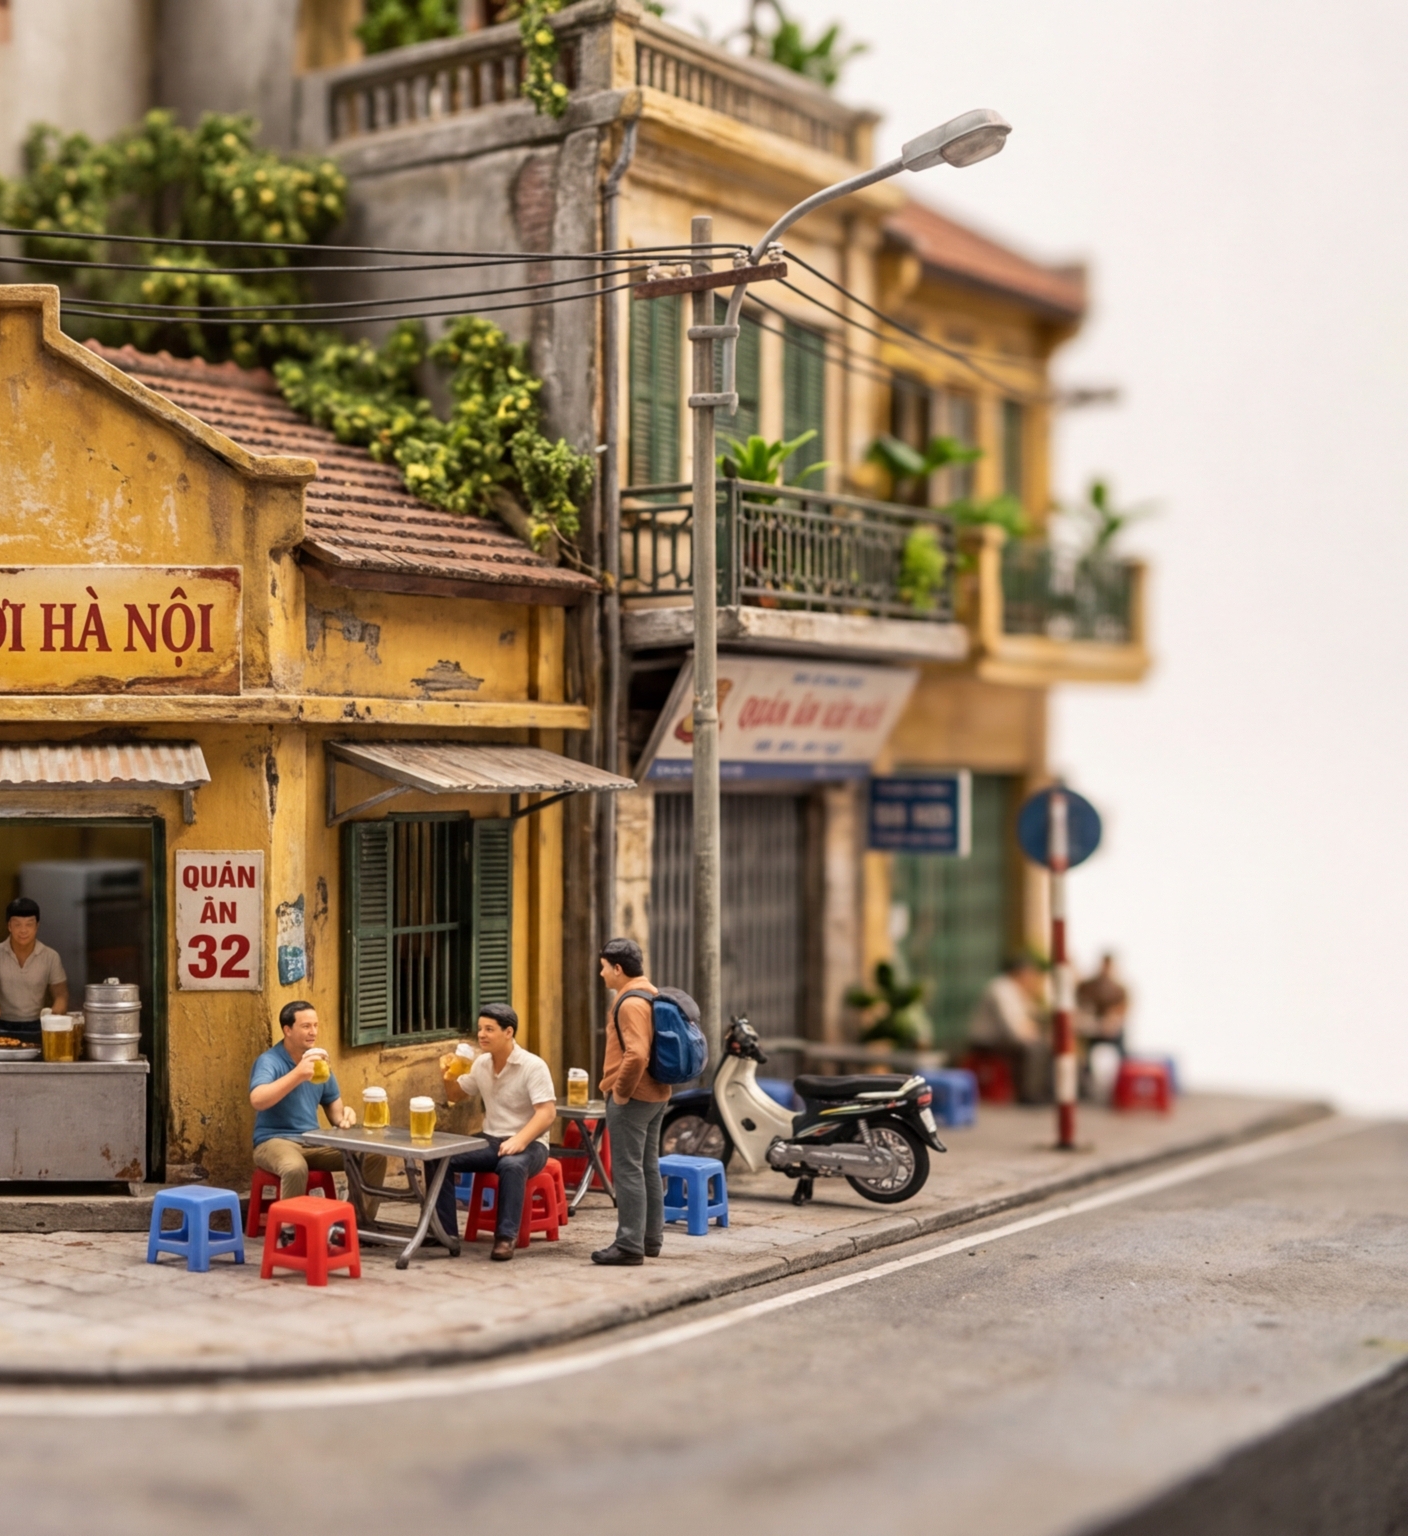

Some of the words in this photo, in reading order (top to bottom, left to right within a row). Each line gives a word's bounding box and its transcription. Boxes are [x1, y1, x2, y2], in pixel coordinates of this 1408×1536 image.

[39, 585, 113, 652] HÀ
[123, 586, 215, 668] NỘI
[199, 895, 237, 924] ĂN
[187, 934, 250, 979] 32
